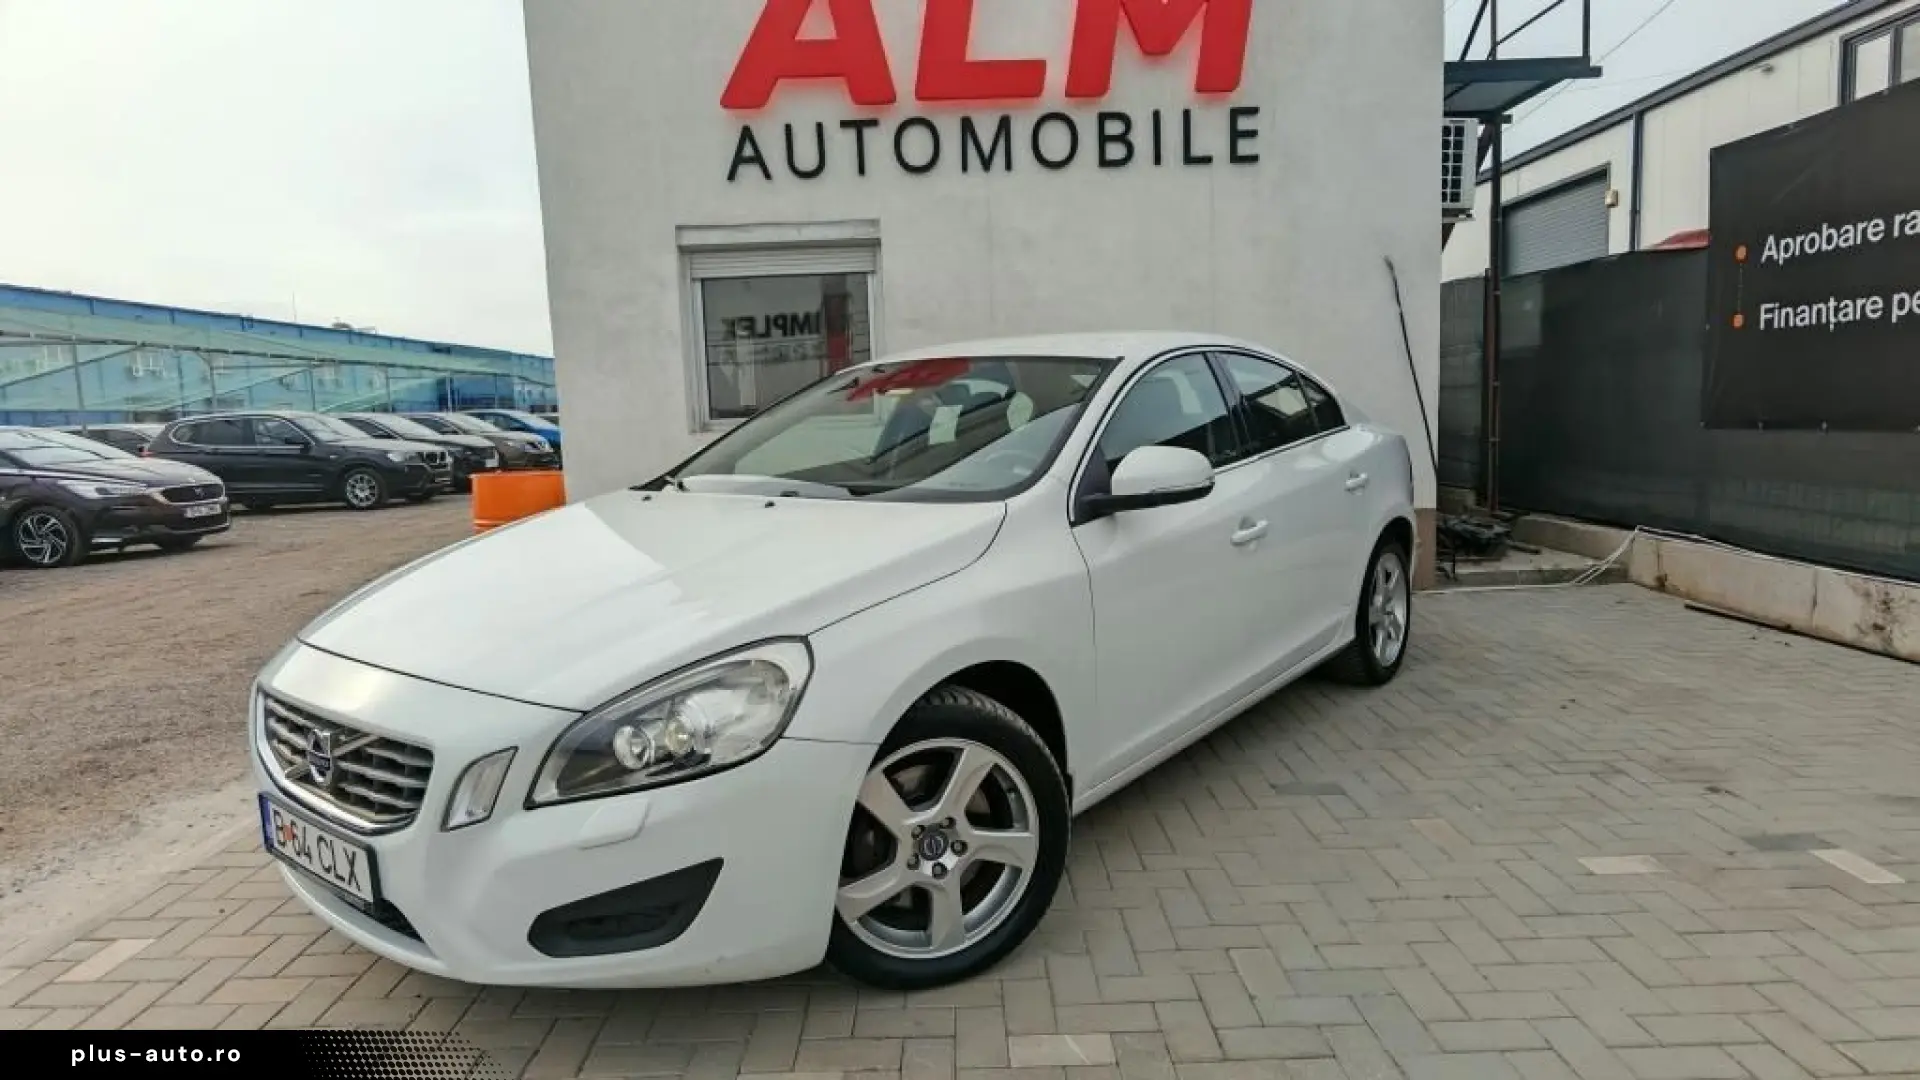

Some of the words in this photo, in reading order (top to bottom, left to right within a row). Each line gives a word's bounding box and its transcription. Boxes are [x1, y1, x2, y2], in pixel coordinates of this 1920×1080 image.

[719, 0, 1254, 110] ALM
[727, 106, 1261, 182] AUTOMOBILE
[1760, 217, 1886, 266] Aprobare
[1892, 209, 1920, 239] ra
[1759, 295, 1884, 333] Finanțare
[273, 809, 287, 849] B
[290, 818, 313, 865] 64
[316, 833, 362, 893] CLX
